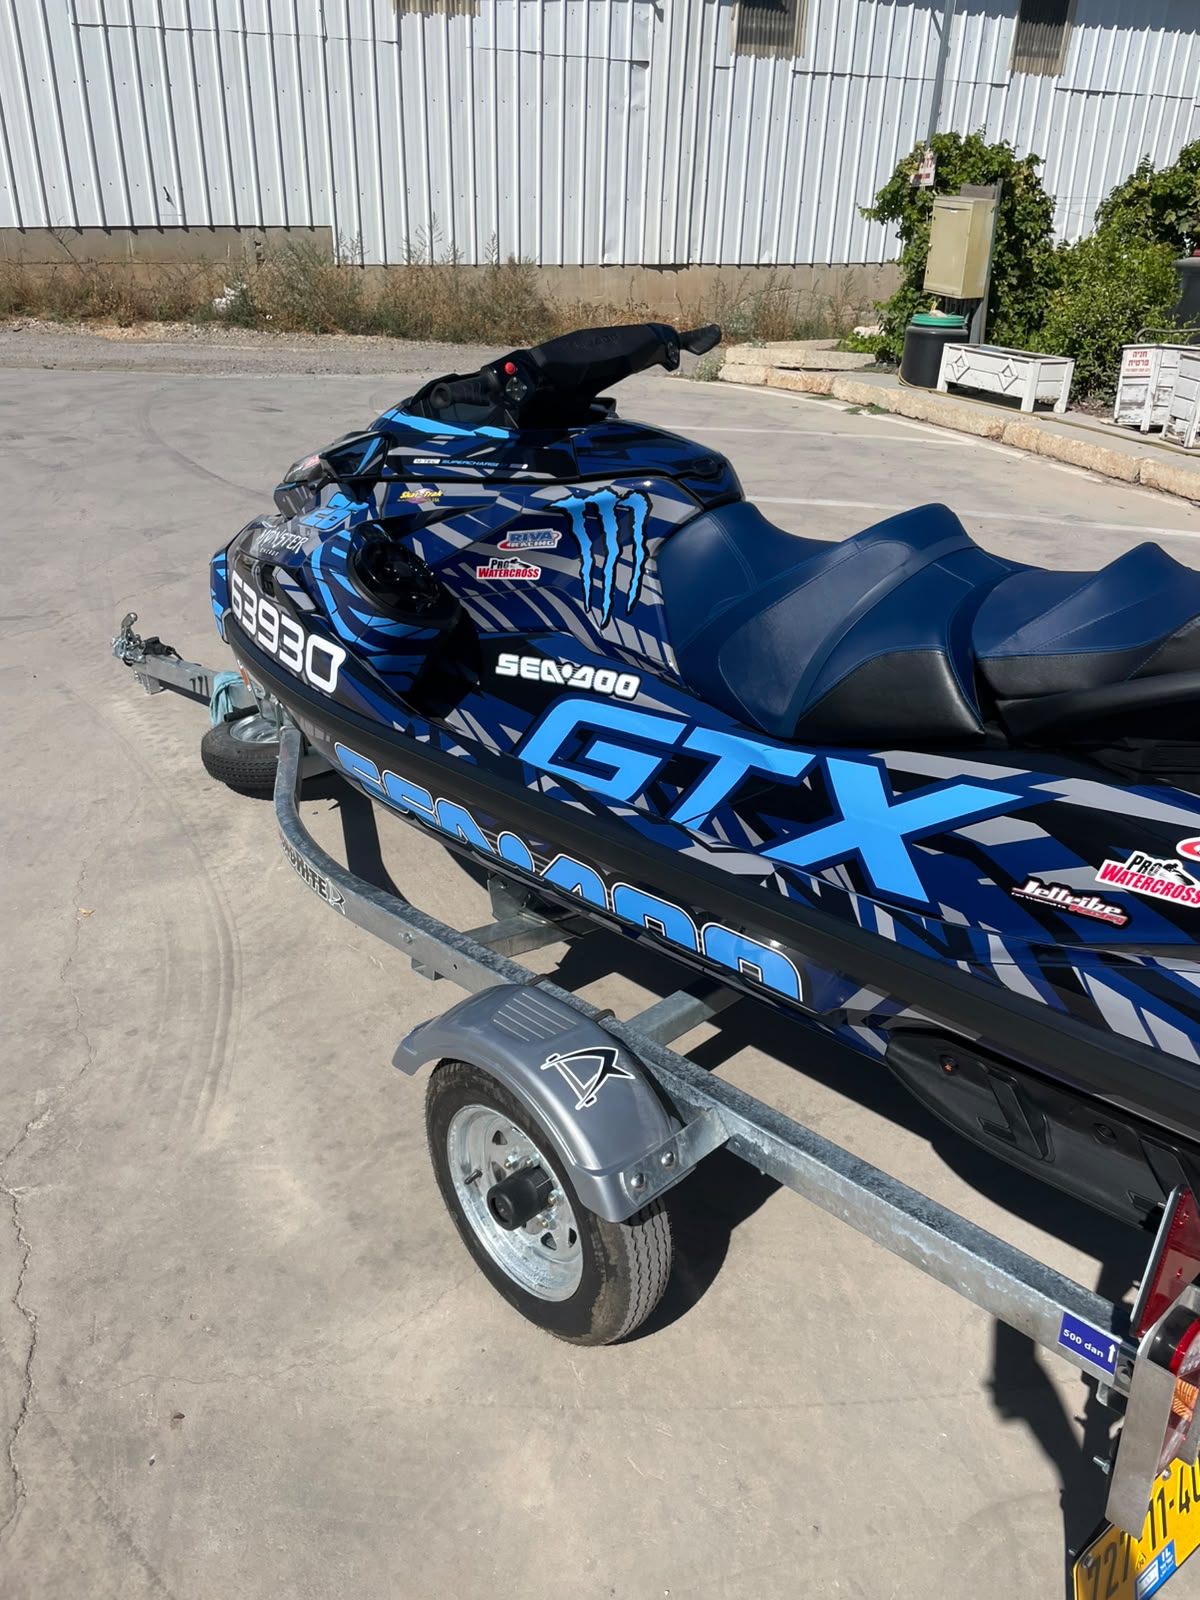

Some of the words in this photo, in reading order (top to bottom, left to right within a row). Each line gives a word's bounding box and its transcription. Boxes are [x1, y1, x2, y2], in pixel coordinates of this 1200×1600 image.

[256, 526, 309, 554] MONSTER
[508, 530, 554, 542] RIVA
[508, 540, 554, 548] RACING
[477, 567, 540, 578] WATERCROSS
[231, 569, 347, 694] 63930
[518, 698, 1025, 904] GTX
[1126, 854, 1163, 877] PRO
[1063, 1328, 1083, 1345] 500
[1083, 1342, 1105, 1358] dan
